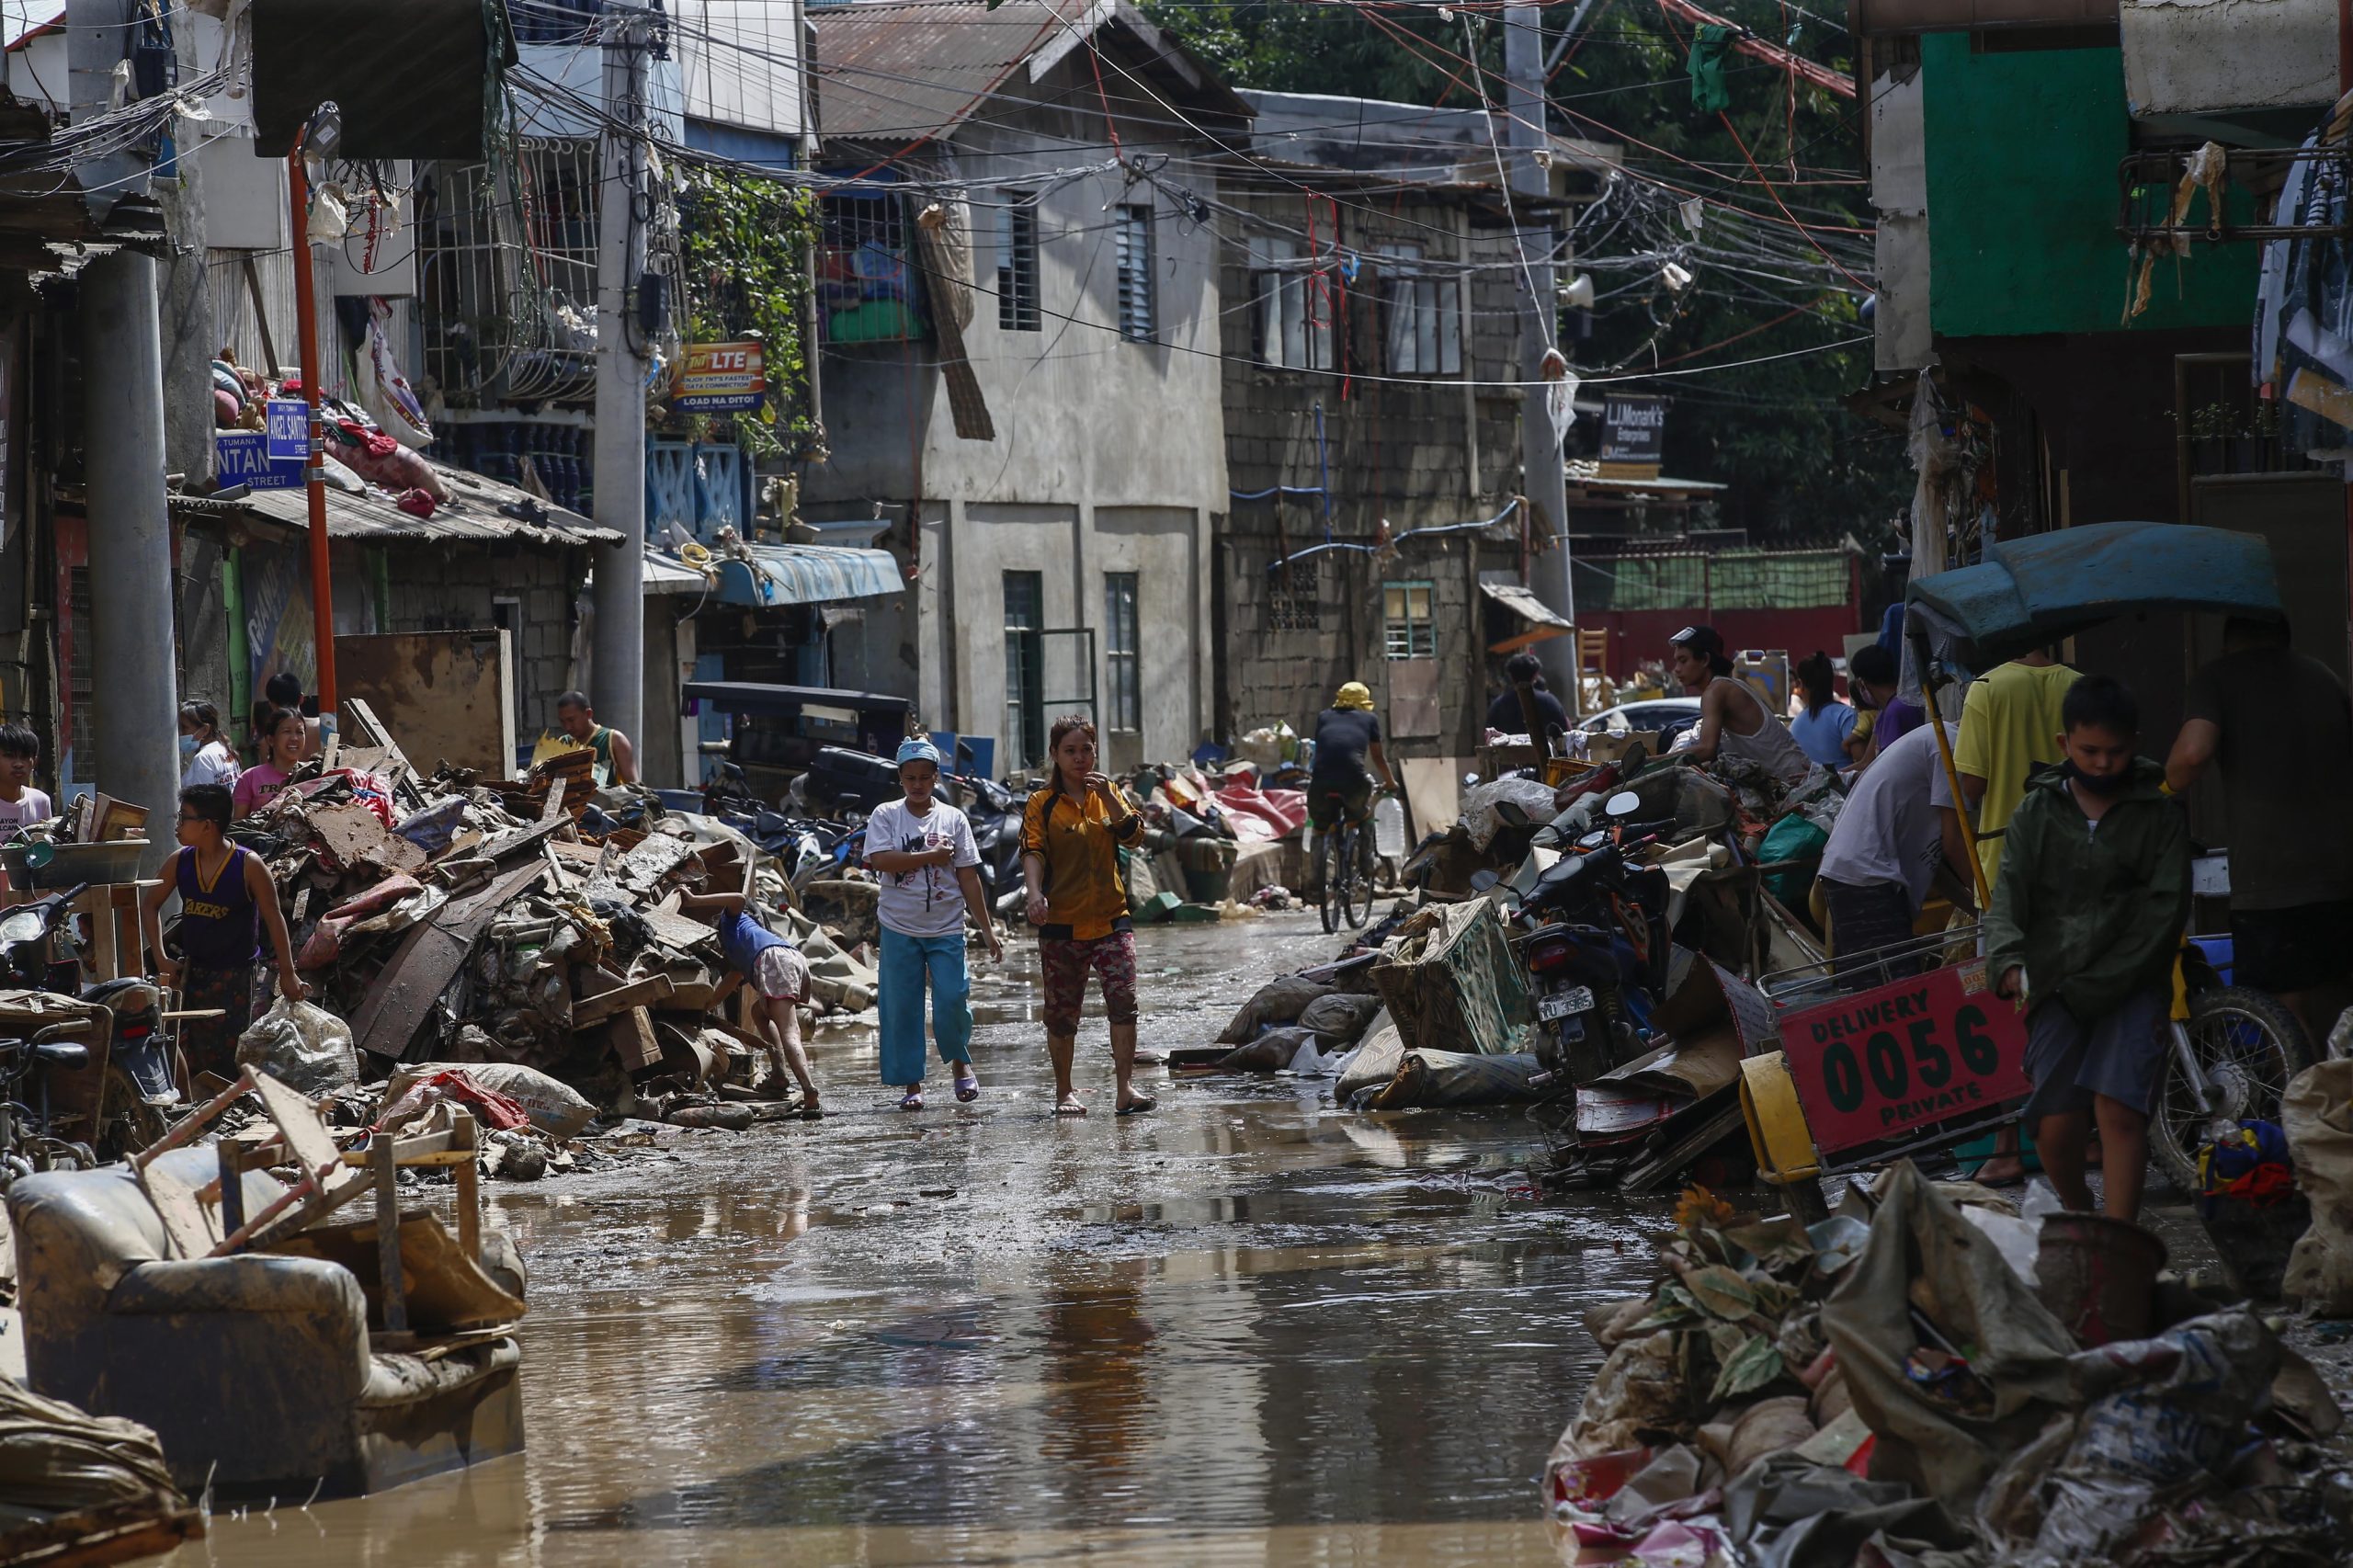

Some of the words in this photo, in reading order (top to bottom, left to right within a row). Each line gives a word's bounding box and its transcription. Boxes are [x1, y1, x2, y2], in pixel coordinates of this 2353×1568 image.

[711, 352, 746, 369] LTE
[684, 397, 710, 405] LOAD
[712, 396, 726, 404] NA
[729, 395, 754, 403] DITO!
[270, 415, 287, 440] ANGEL
[287, 415, 308, 441] SANTOS
[224, 437, 257, 447] TUMANA
[247, 475, 287, 487] STREET
[1810, 988, 1928, 1044] DELIVERY
[1823, 1005, 1999, 1113] 0056
[1880, 1081, 1983, 1127] PRIVATE
